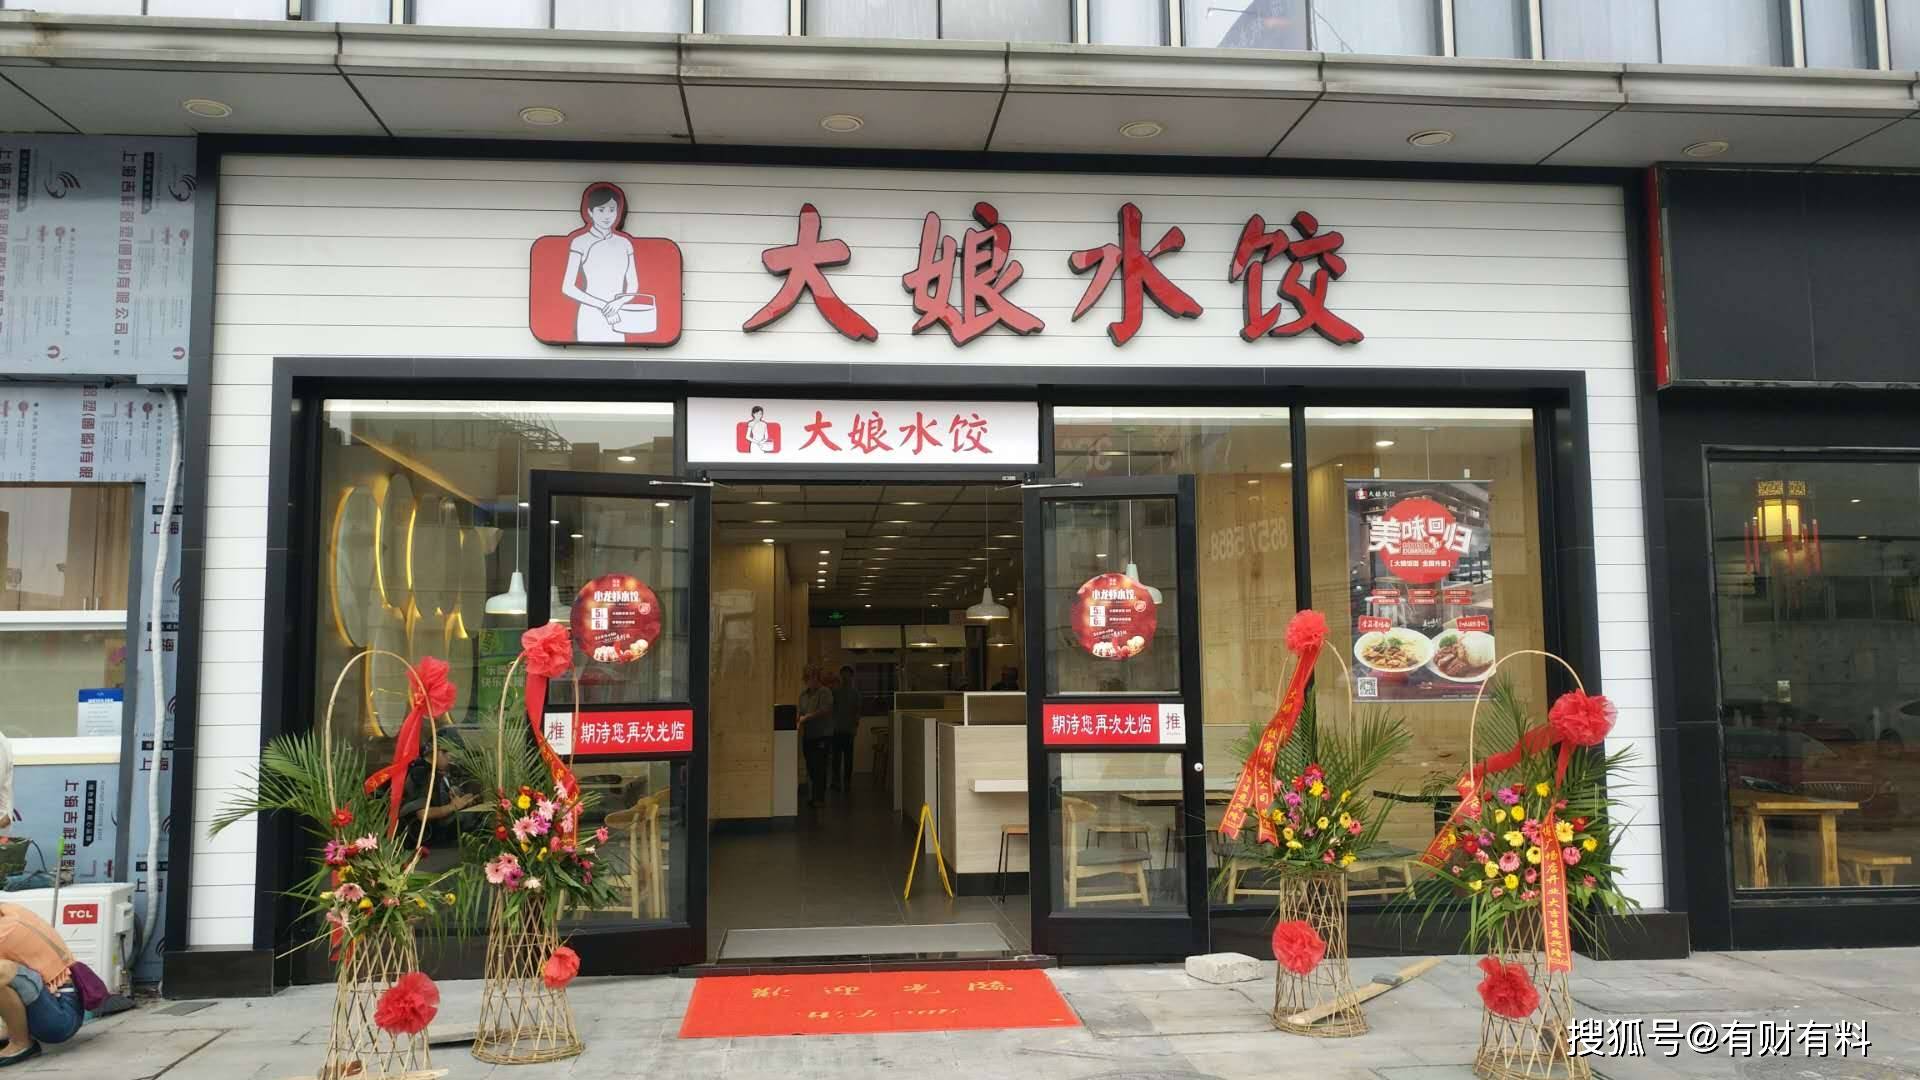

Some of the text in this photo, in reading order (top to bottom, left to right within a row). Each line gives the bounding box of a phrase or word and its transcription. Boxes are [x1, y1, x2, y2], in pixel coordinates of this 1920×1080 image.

[742, 202, 1364, 347] 大娘水饺
[798, 410, 993, 455] 大娘水饺
[549, 721, 565, 741] 推
[580, 721, 686, 745] 期待您再次光临
[1052, 713, 1152, 736] 期待您再次光临
[1165, 712, 1181, 731] 推
[68, 910, 93, 918] TCL
